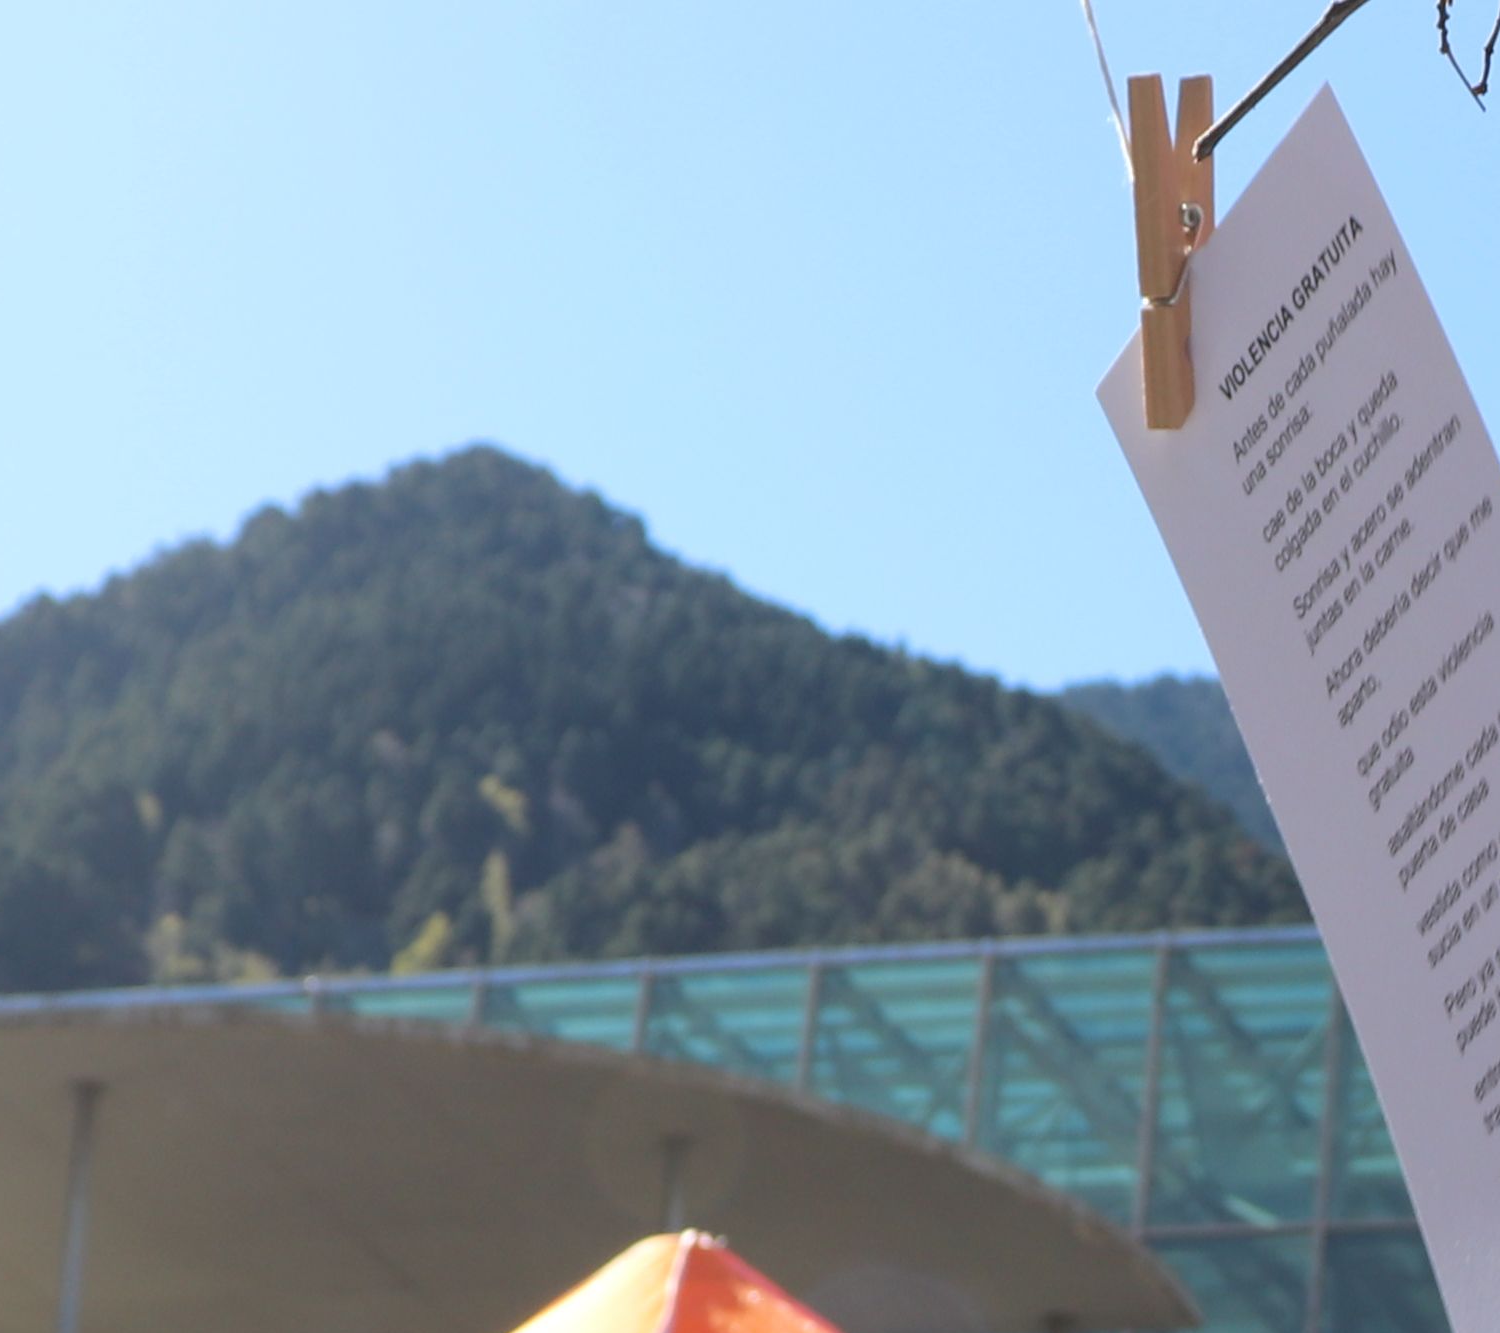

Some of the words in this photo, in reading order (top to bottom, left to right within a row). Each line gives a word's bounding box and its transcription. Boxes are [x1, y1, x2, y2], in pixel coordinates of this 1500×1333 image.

[1219, 304, 1293, 400] VIOLENCIA
[1291, 215, 1362, 310] GRATUITA
[1233, 413, 1267, 464] Antes
[1267, 392, 1285, 419] de
[1285, 352, 1316, 398] cada
[1315, 281, 1371, 364] puñalada
[1369, 248, 1396, 288] hay
[1242, 460, 1266, 495] una
[1265, 401, 1312, 467] sonrisa:
[1262, 508, 1286, 543] cae
[1285, 487, 1303, 515] de
[1301, 470, 1316, 494] la
[1314, 432, 1347, 478] boca
[1357, 370, 1397, 426] queda
[1274, 508, 1322, 572] colgada
[1321, 486, 1339, 514] en
[1339, 465, 1353, 493] el
[1352, 412, 1403, 477] cuchillo.
[1293, 557, 1340, 620] Sonrisa
[1350, 503, 1386, 554] acero
[1386, 482, 1403, 511] se
[1404, 414, 1460, 490] adentran
[1304, 598, 1343, 656] juntas
[1343, 577, 1361, 606] en
[1358, 560, 1375, 585] la
[1374, 518, 1413, 568] carne.
[1325, 647, 1363, 699] Ahora
[1362, 590, 1410, 654] debería
[1410, 551, 1441, 599] decir
[1443, 522, 1469, 561] que
[1469, 496, 1492, 531] me
[1357, 741, 1381, 777] que
[1381, 709, 1409, 749] odio
[1409, 675, 1437, 717] esta
[1437, 611, 1494, 683] violencia
[1368, 746, 1414, 812] gratuita
